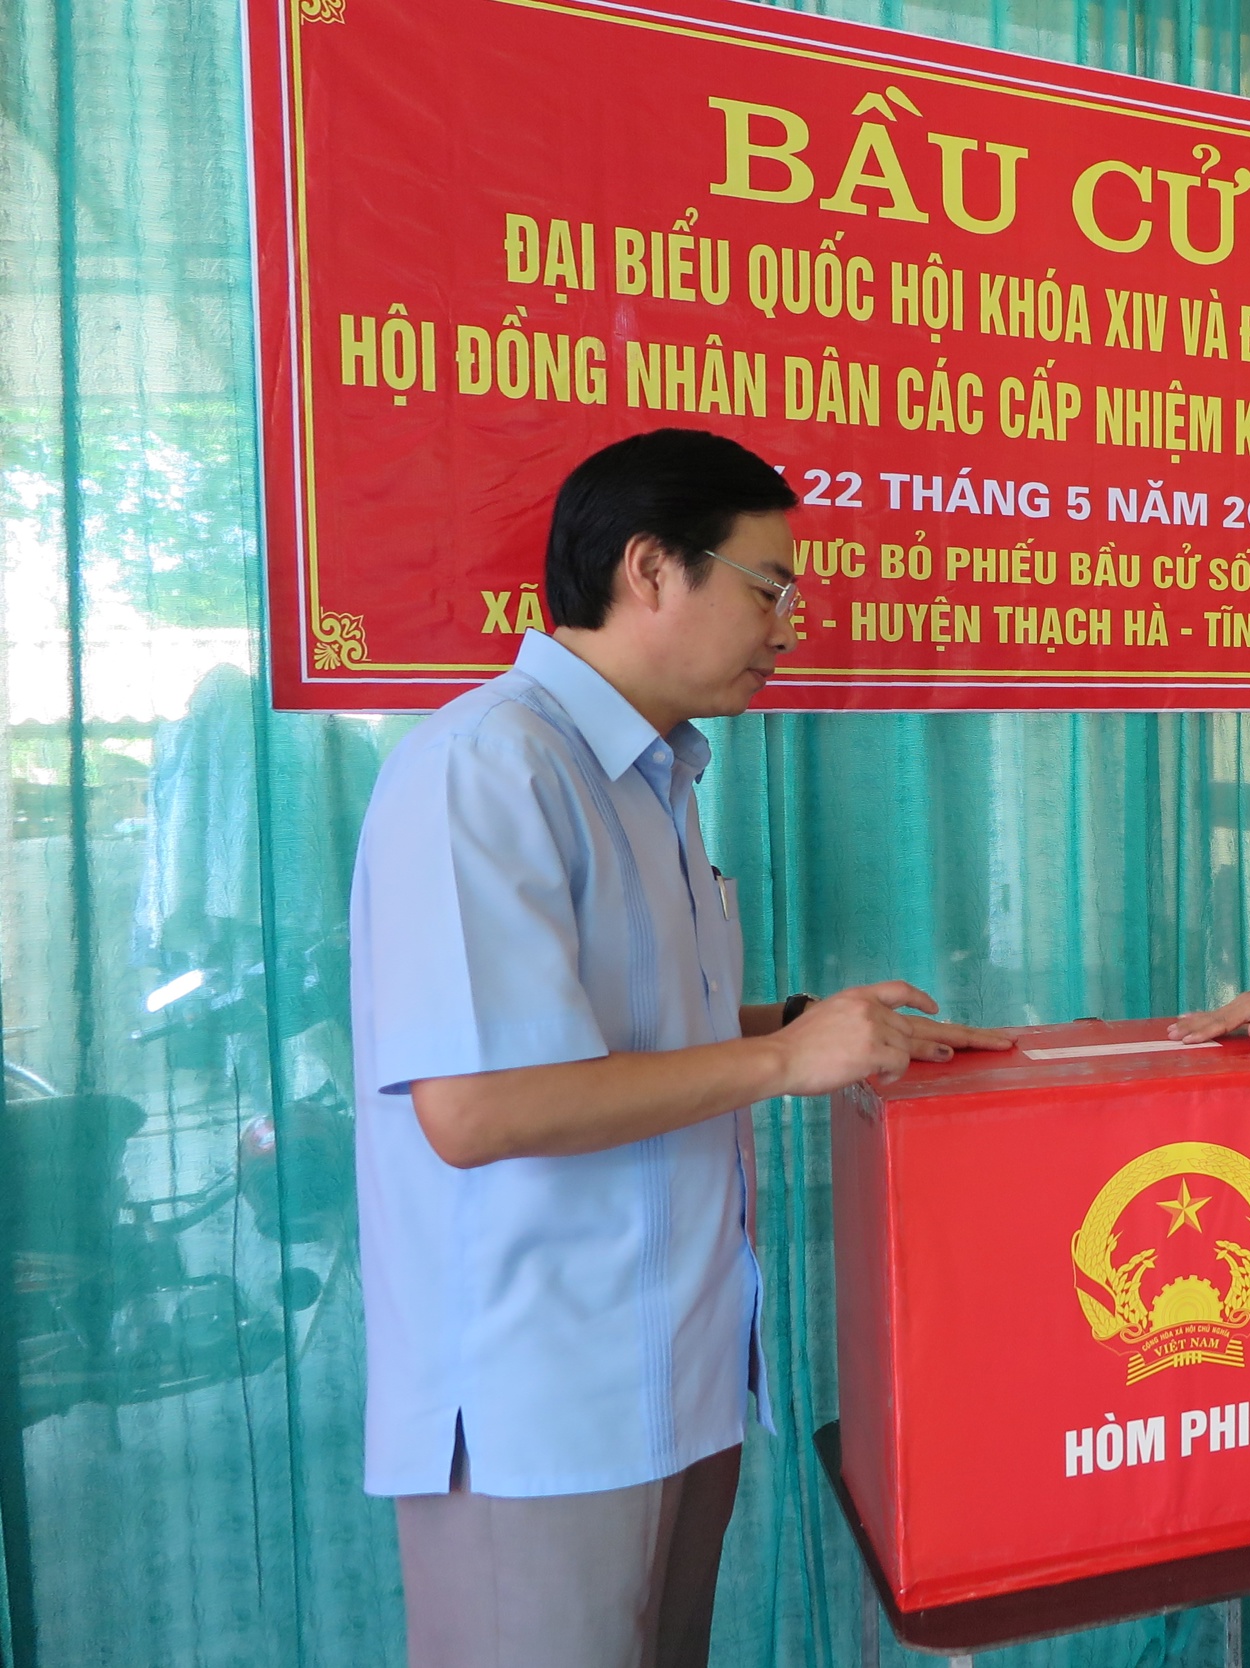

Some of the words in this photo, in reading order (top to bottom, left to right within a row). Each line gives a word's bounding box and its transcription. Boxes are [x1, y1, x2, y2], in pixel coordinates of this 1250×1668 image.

[707, 85, 1029, 236] BẦU
[503, 212, 596, 305] ĐẠI
[614, 206, 730, 306] BIỂU
[748, 230, 875, 322] QUỐC
[891, 252, 964, 344] HỘI
[979, 267, 1092, 345] KHÓA
[1104, 288, 1168, 353] XIV
[1179, 288, 1229, 360] VÀ
[340, 302, 437, 407] HỘI
[455, 305, 607, 405] ĐỒNG
[626, 333, 767, 418] NHÂN
[784, 345, 880, 427] DÂN
[896, 356, 984, 435] CÁC
[999, 358, 1082, 442] CẤP
[1095, 379, 1222, 464] NHIỆM
[803, 468, 863, 508] 22
[879, 467, 1050, 519] THÁNG
[1066, 485, 1091, 521] 5
[1107, 479, 1208, 527] NĂM
[880, 529, 932, 581] BỎ
[946, 537, 1057, 585] PHIẾU
[1070, 541, 1141, 588] BẦU
[1152, 542, 1202, 590] CỬ
[480, 582, 546, 634] XÃ
[822, 619, 837, 628] -
[851, 595, 981, 652] HUYỆN
[993, 605, 1111, 654] THẠCH
[1124, 602, 1169, 647] HÀ
[1180, 627, 1193, 636] -
[1154, 1339, 1187, 1357] VIỆT
[1189, 1337, 1220, 1349] NAM
[1065, 1412, 1166, 1478] HÒM
